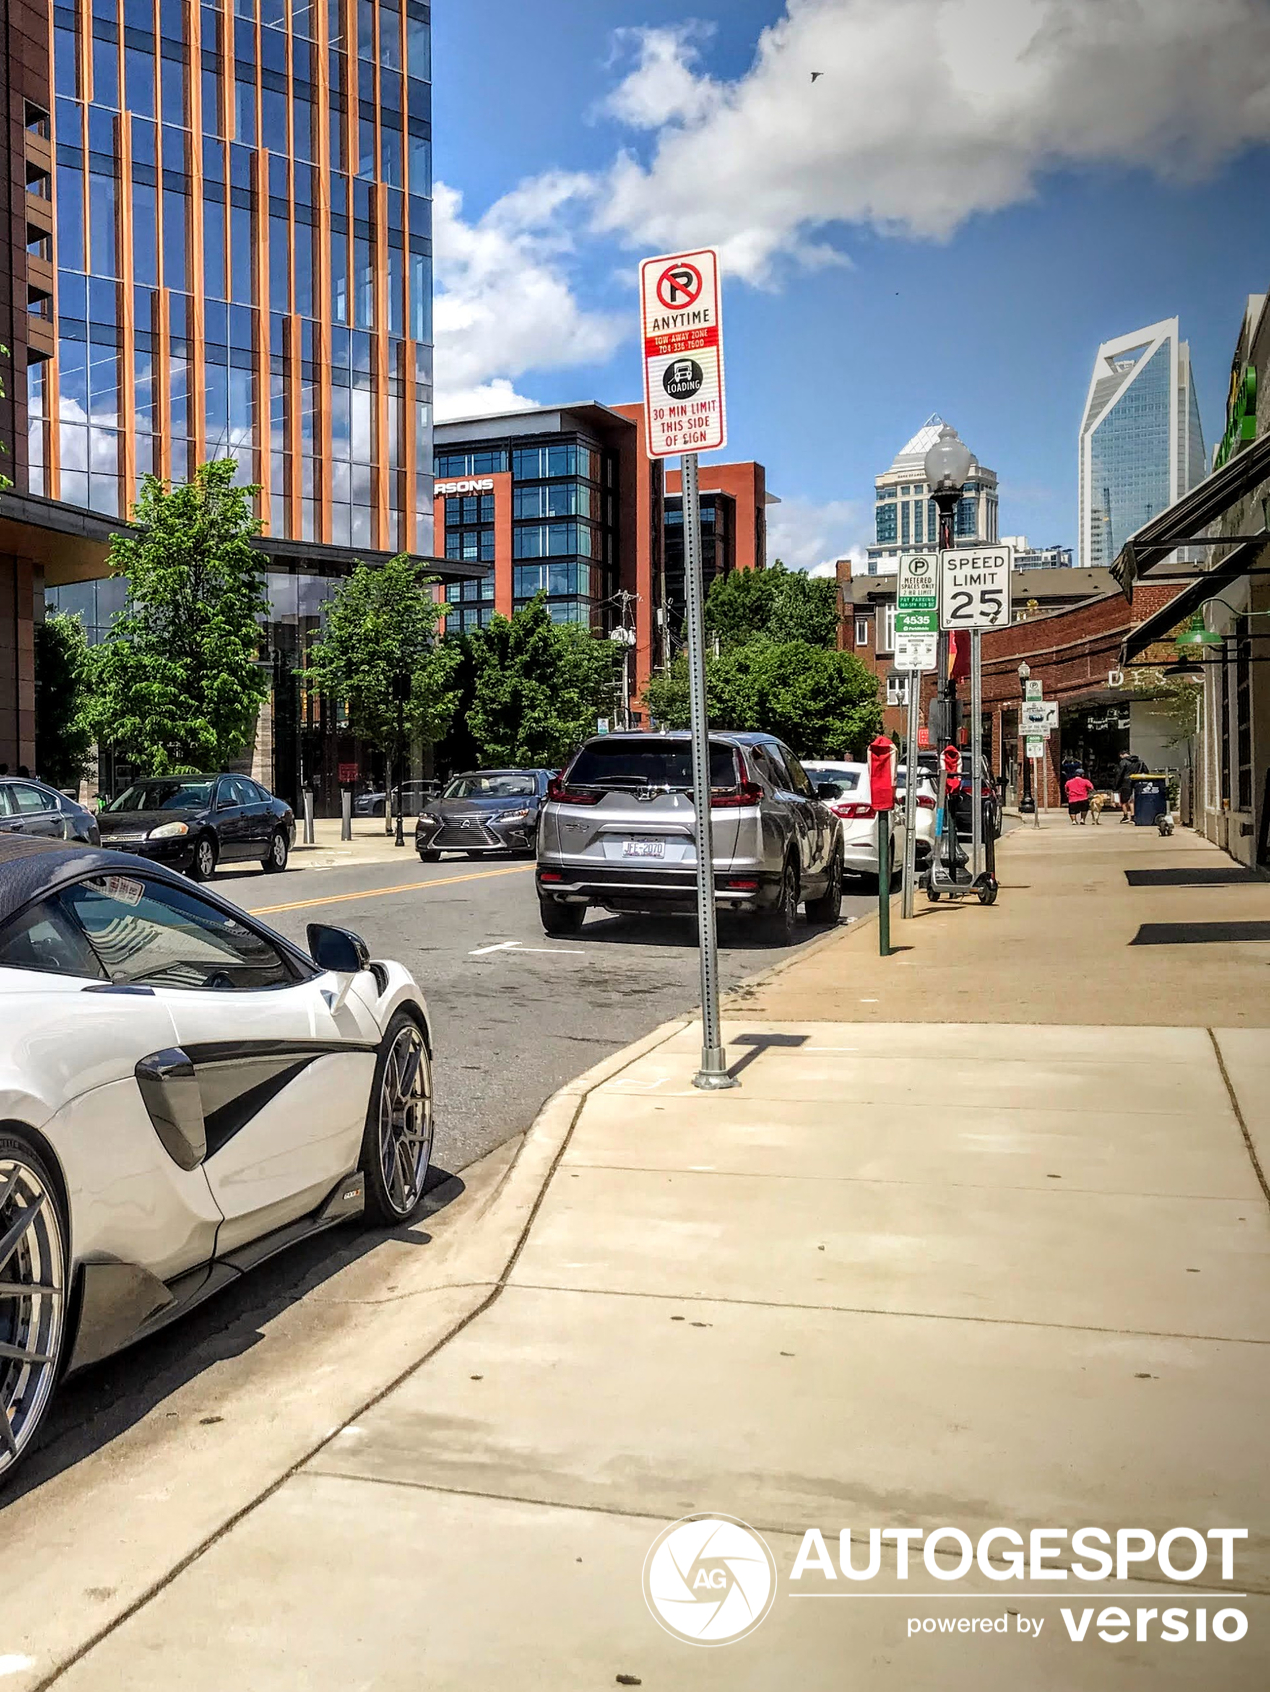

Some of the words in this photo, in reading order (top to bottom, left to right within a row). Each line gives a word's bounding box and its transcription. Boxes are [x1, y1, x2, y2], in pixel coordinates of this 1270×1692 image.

[652, 309, 710, 332] ANYTIME
[691, 329, 708, 340] ZONE
[667, 380, 700, 394] LOADING
[653, 409, 665, 420] 30
[669, 404, 687, 418] MIN
[691, 400, 717, 414] LIMIT
[661, 421, 683, 434] THIS
[688, 416, 710, 429] SIDE
[665, 435, 678, 447] OF
[683, 430, 707, 445] SIGN
[947, 556, 1005, 571] SPEED
[954, 572, 998, 587] LIMIT
[950, 589, 1003, 620] 25
[903, 616, 930, 625] 4535
